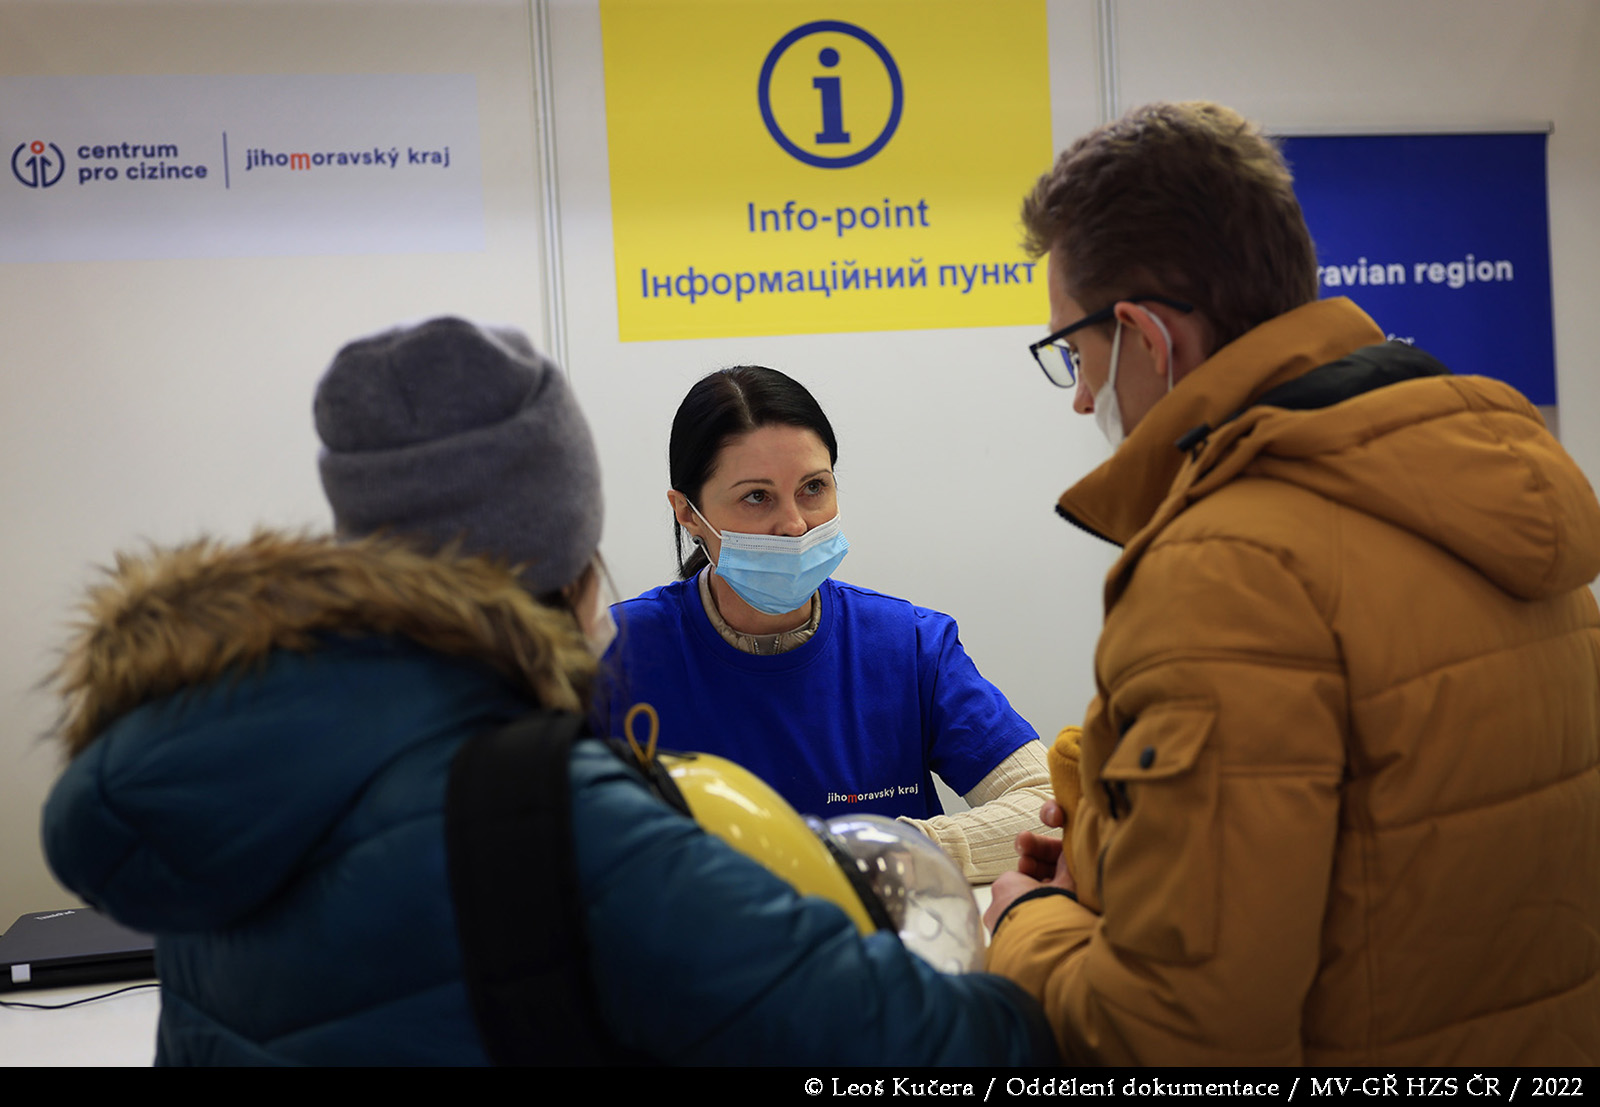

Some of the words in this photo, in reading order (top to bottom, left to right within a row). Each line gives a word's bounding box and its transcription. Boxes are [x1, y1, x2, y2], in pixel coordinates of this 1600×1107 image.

[77, 141, 179, 160] centrum
[245, 147, 400, 172] jihomoravský
[407, 146, 451, 169] kraj
[77, 164, 119, 186] pro
[125, 159, 208, 182] cizince
[747, 197, 931, 238] Info-point
[640, 257, 928, 304] Інформаційний
[938, 261, 1037, 294] пункт
[1316, 256, 1406, 287] ravian
[1414, 254, 1514, 288] region
[826, 786, 895, 804] jihomoravský
[897, 783, 919, 795] kraj
